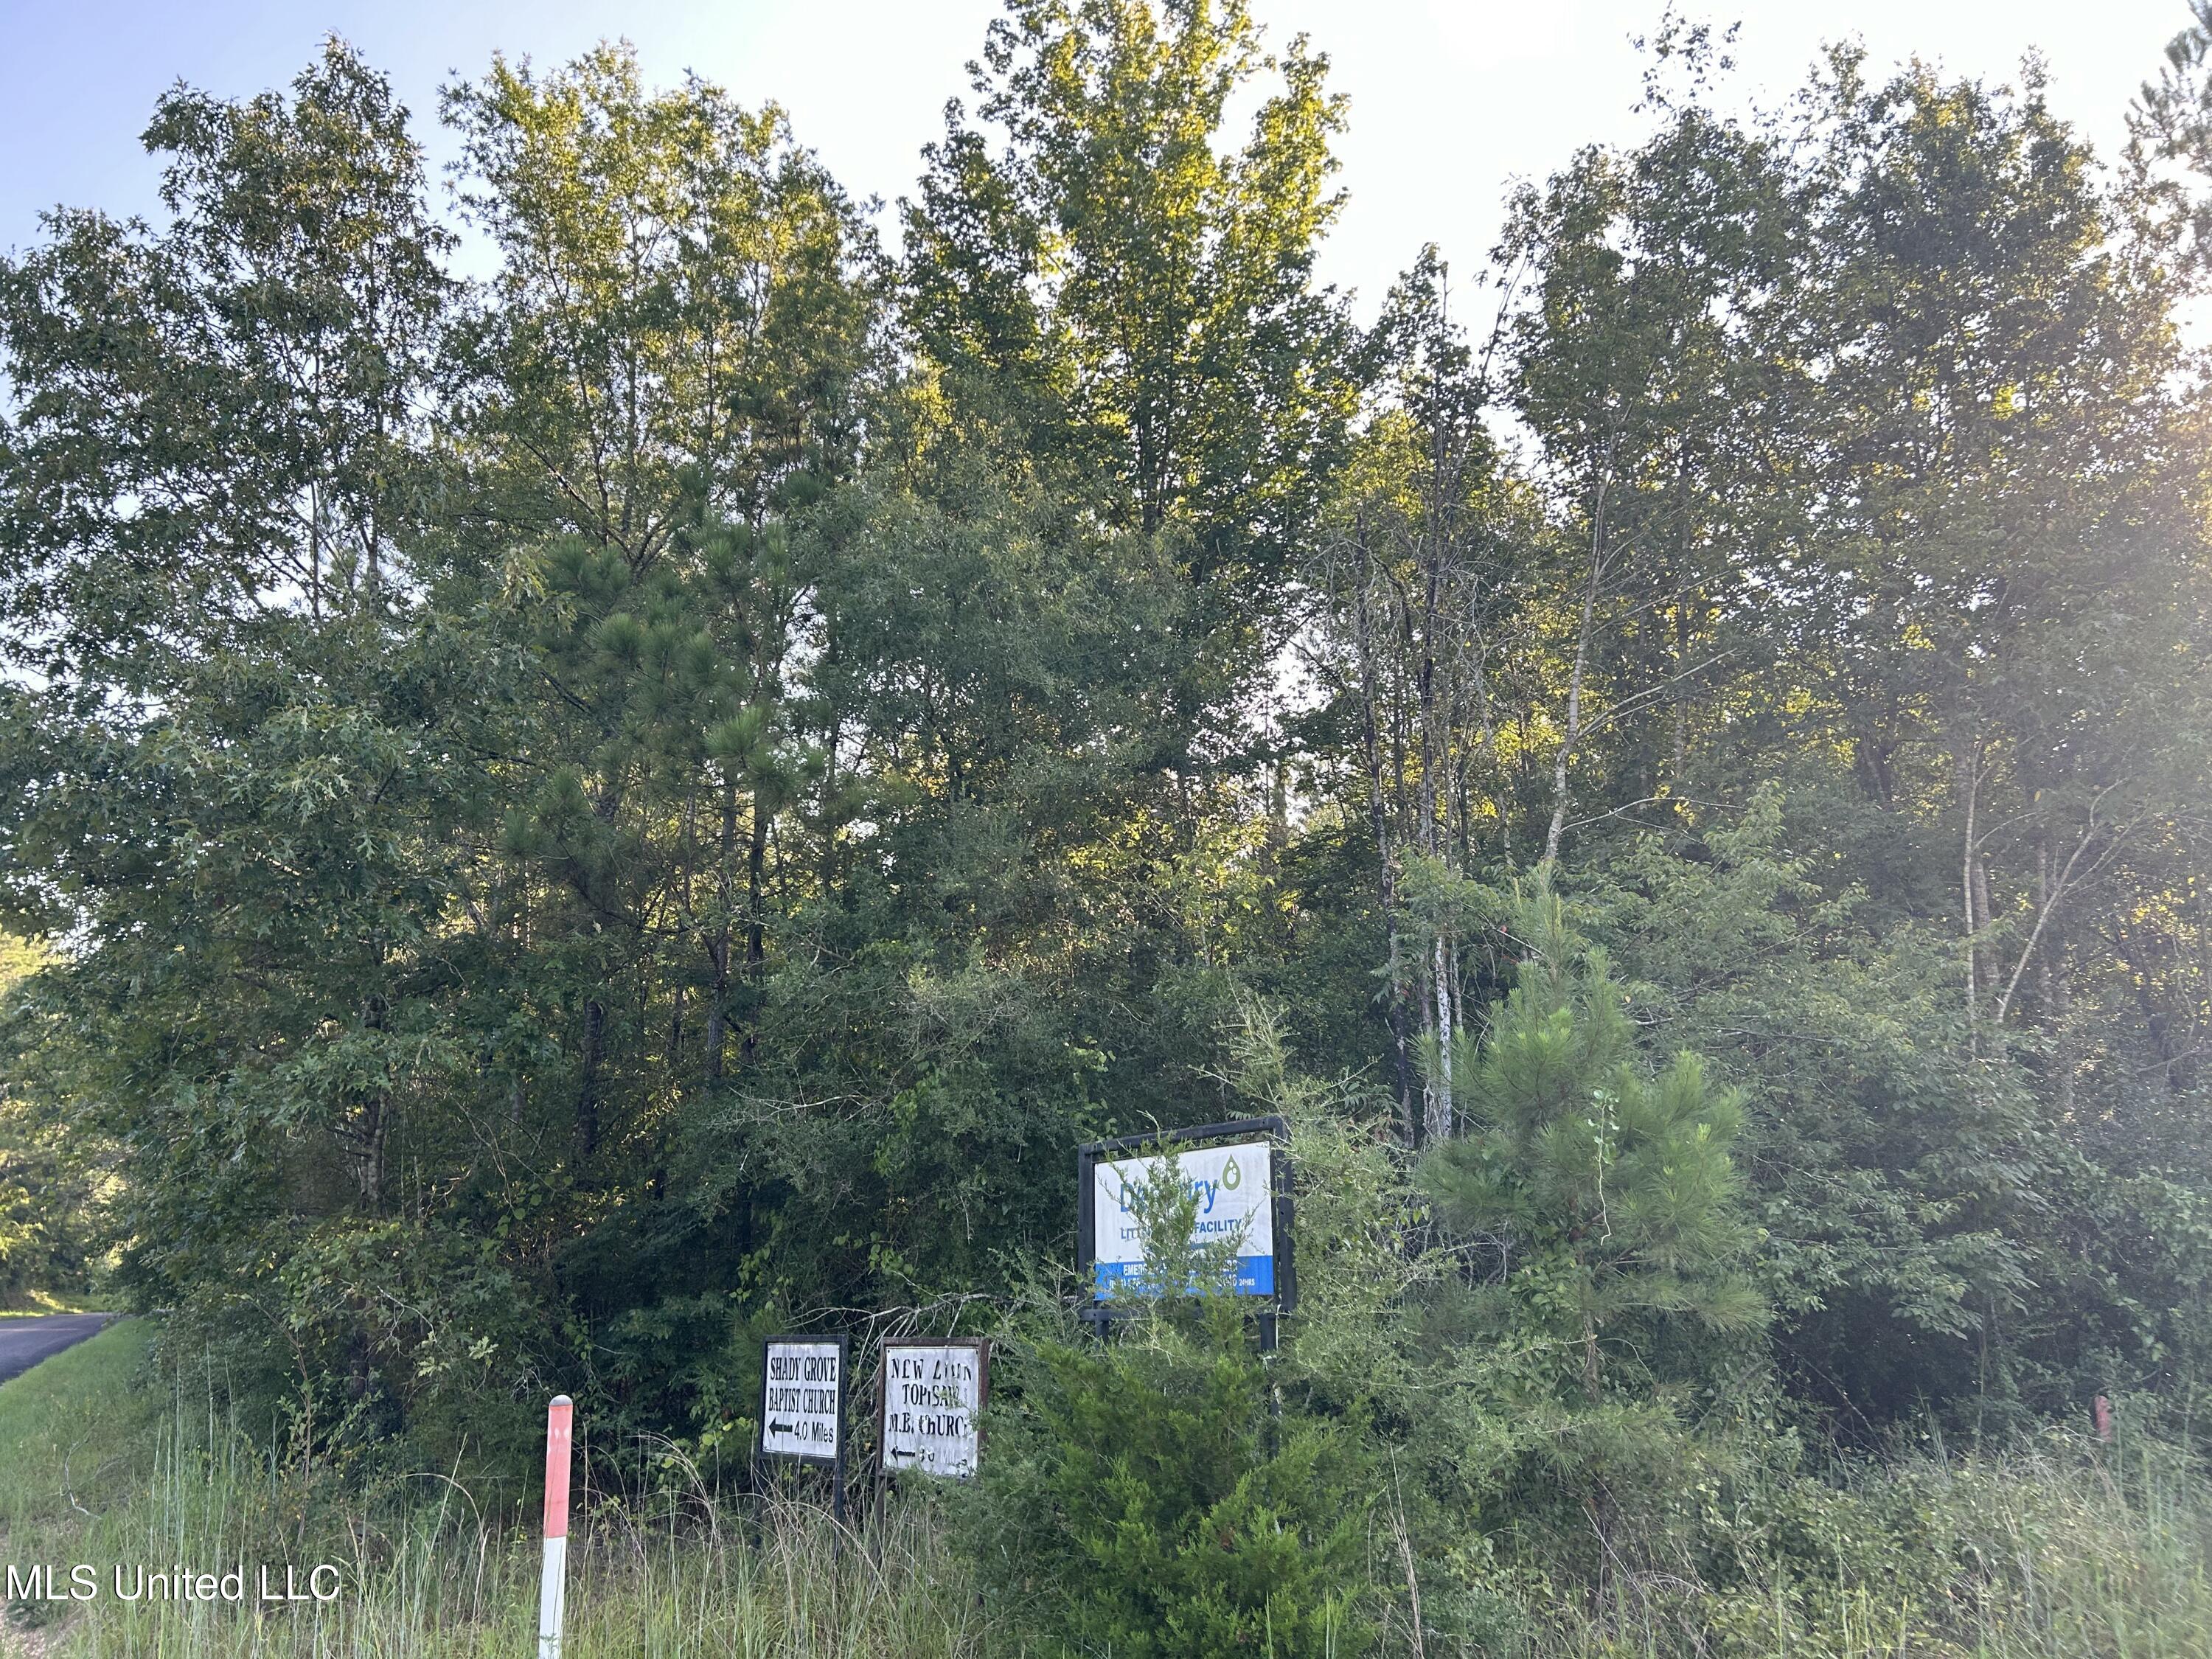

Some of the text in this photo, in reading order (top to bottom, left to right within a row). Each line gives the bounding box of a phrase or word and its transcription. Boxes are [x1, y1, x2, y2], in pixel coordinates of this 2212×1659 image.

[1195, 1219, 1242, 1234] FACILITY
[1239, 1278, 1255, 1287] 24HRS
[770, 1357, 837, 1382] SHADY GROVE
[891, 1358, 924, 1379] NEW
[768, 1388, 835, 1415] BAPTIST CHURCH
[794, 1421, 834, 1443] 4.0 Miles
